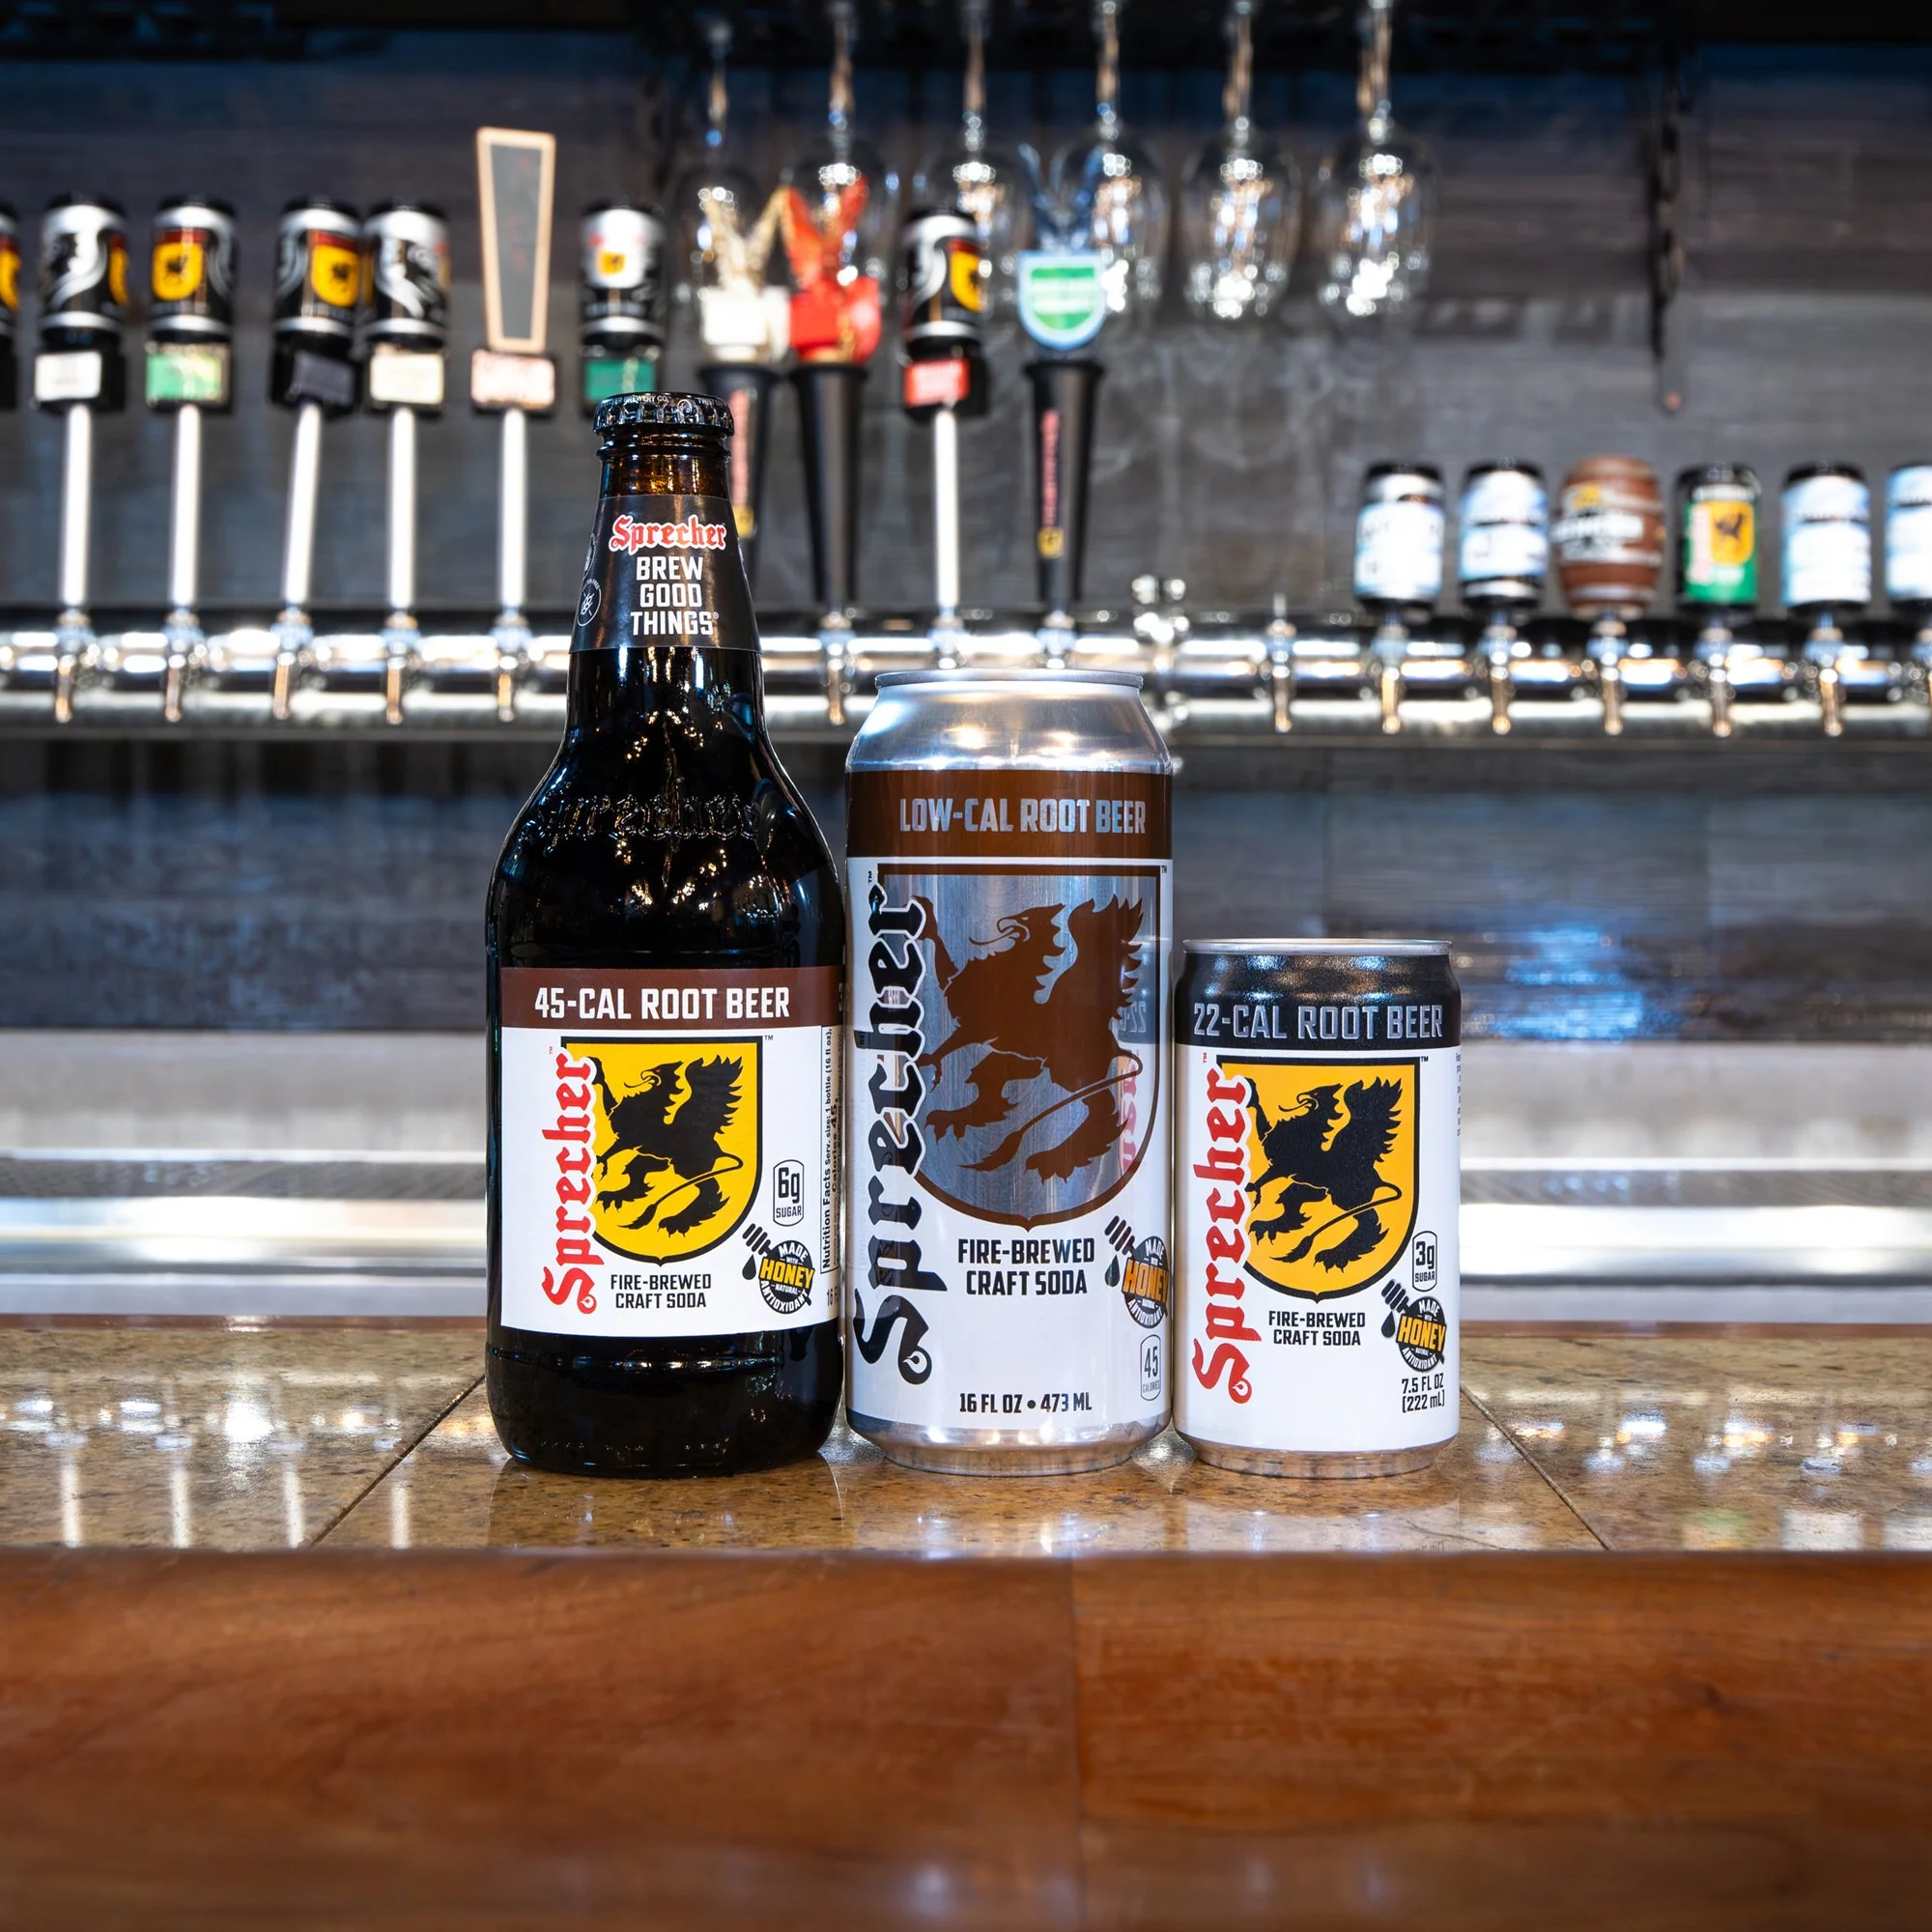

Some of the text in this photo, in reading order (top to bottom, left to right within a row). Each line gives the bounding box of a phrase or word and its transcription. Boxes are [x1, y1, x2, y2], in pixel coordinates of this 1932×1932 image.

[609, 514, 727, 555] Sprecher
[637, 555, 703, 581] BREW
[639, 583, 702, 608] GOOD
[899, 798, 1146, 834] LOW-CAL ROOT BEER
[534, 986, 790, 1020] 45-CAL ROOT BEER
[1193, 1003, 1443, 1039] 22-CAL ROOT BEER
[853, 882, 948, 1385] Sprecher
[541, 1052, 605, 1315] Sprecher
[778, 1167, 800, 1205] 6g
[822, 1168, 831, 1206] Facts
[776, 1207, 802, 1218] SUGAR
[822, 1209, 831, 1268] Nutrition
[958, 1237, 1095, 1264] FIRE-BREWED
[1145, 1238, 1165, 1260] MADE
[1192, 1068, 1262, 1404] Sprecher
[778, 1242, 809, 1263] MADE
[1415, 1241, 1435, 1272] 3g
[611, 1274, 711, 1291] FIRE-BREWED
[759, 1258, 815, 1289] HONEY
[966, 1269, 1088, 1295] CRAFT SODA
[1122, 1259, 1169, 1303] HONEY
[1415, 1271, 1435, 1283] SUGAR
[615, 1293, 707, 1309] CRAFT SODA
[760, 1280, 809, 1312] ANTIOXIDANT
[1418, 1299, 1440, 1317] MADE
[1268, 1310, 1366, 1328] FIRE-BREWED
[1397, 1315, 1446, 1351] HONEY
[1273, 1329, 1361, 1347] CRAFT SODA
[1144, 1346, 1158, 1378] 45
[1402, 1347, 1437, 1370] ANTIOXIDANT
[1402, 1372, 1443, 1394] 7.5 FL OZ
[959, 1392, 1093, 1413] 16 FL OZ 473 ML
